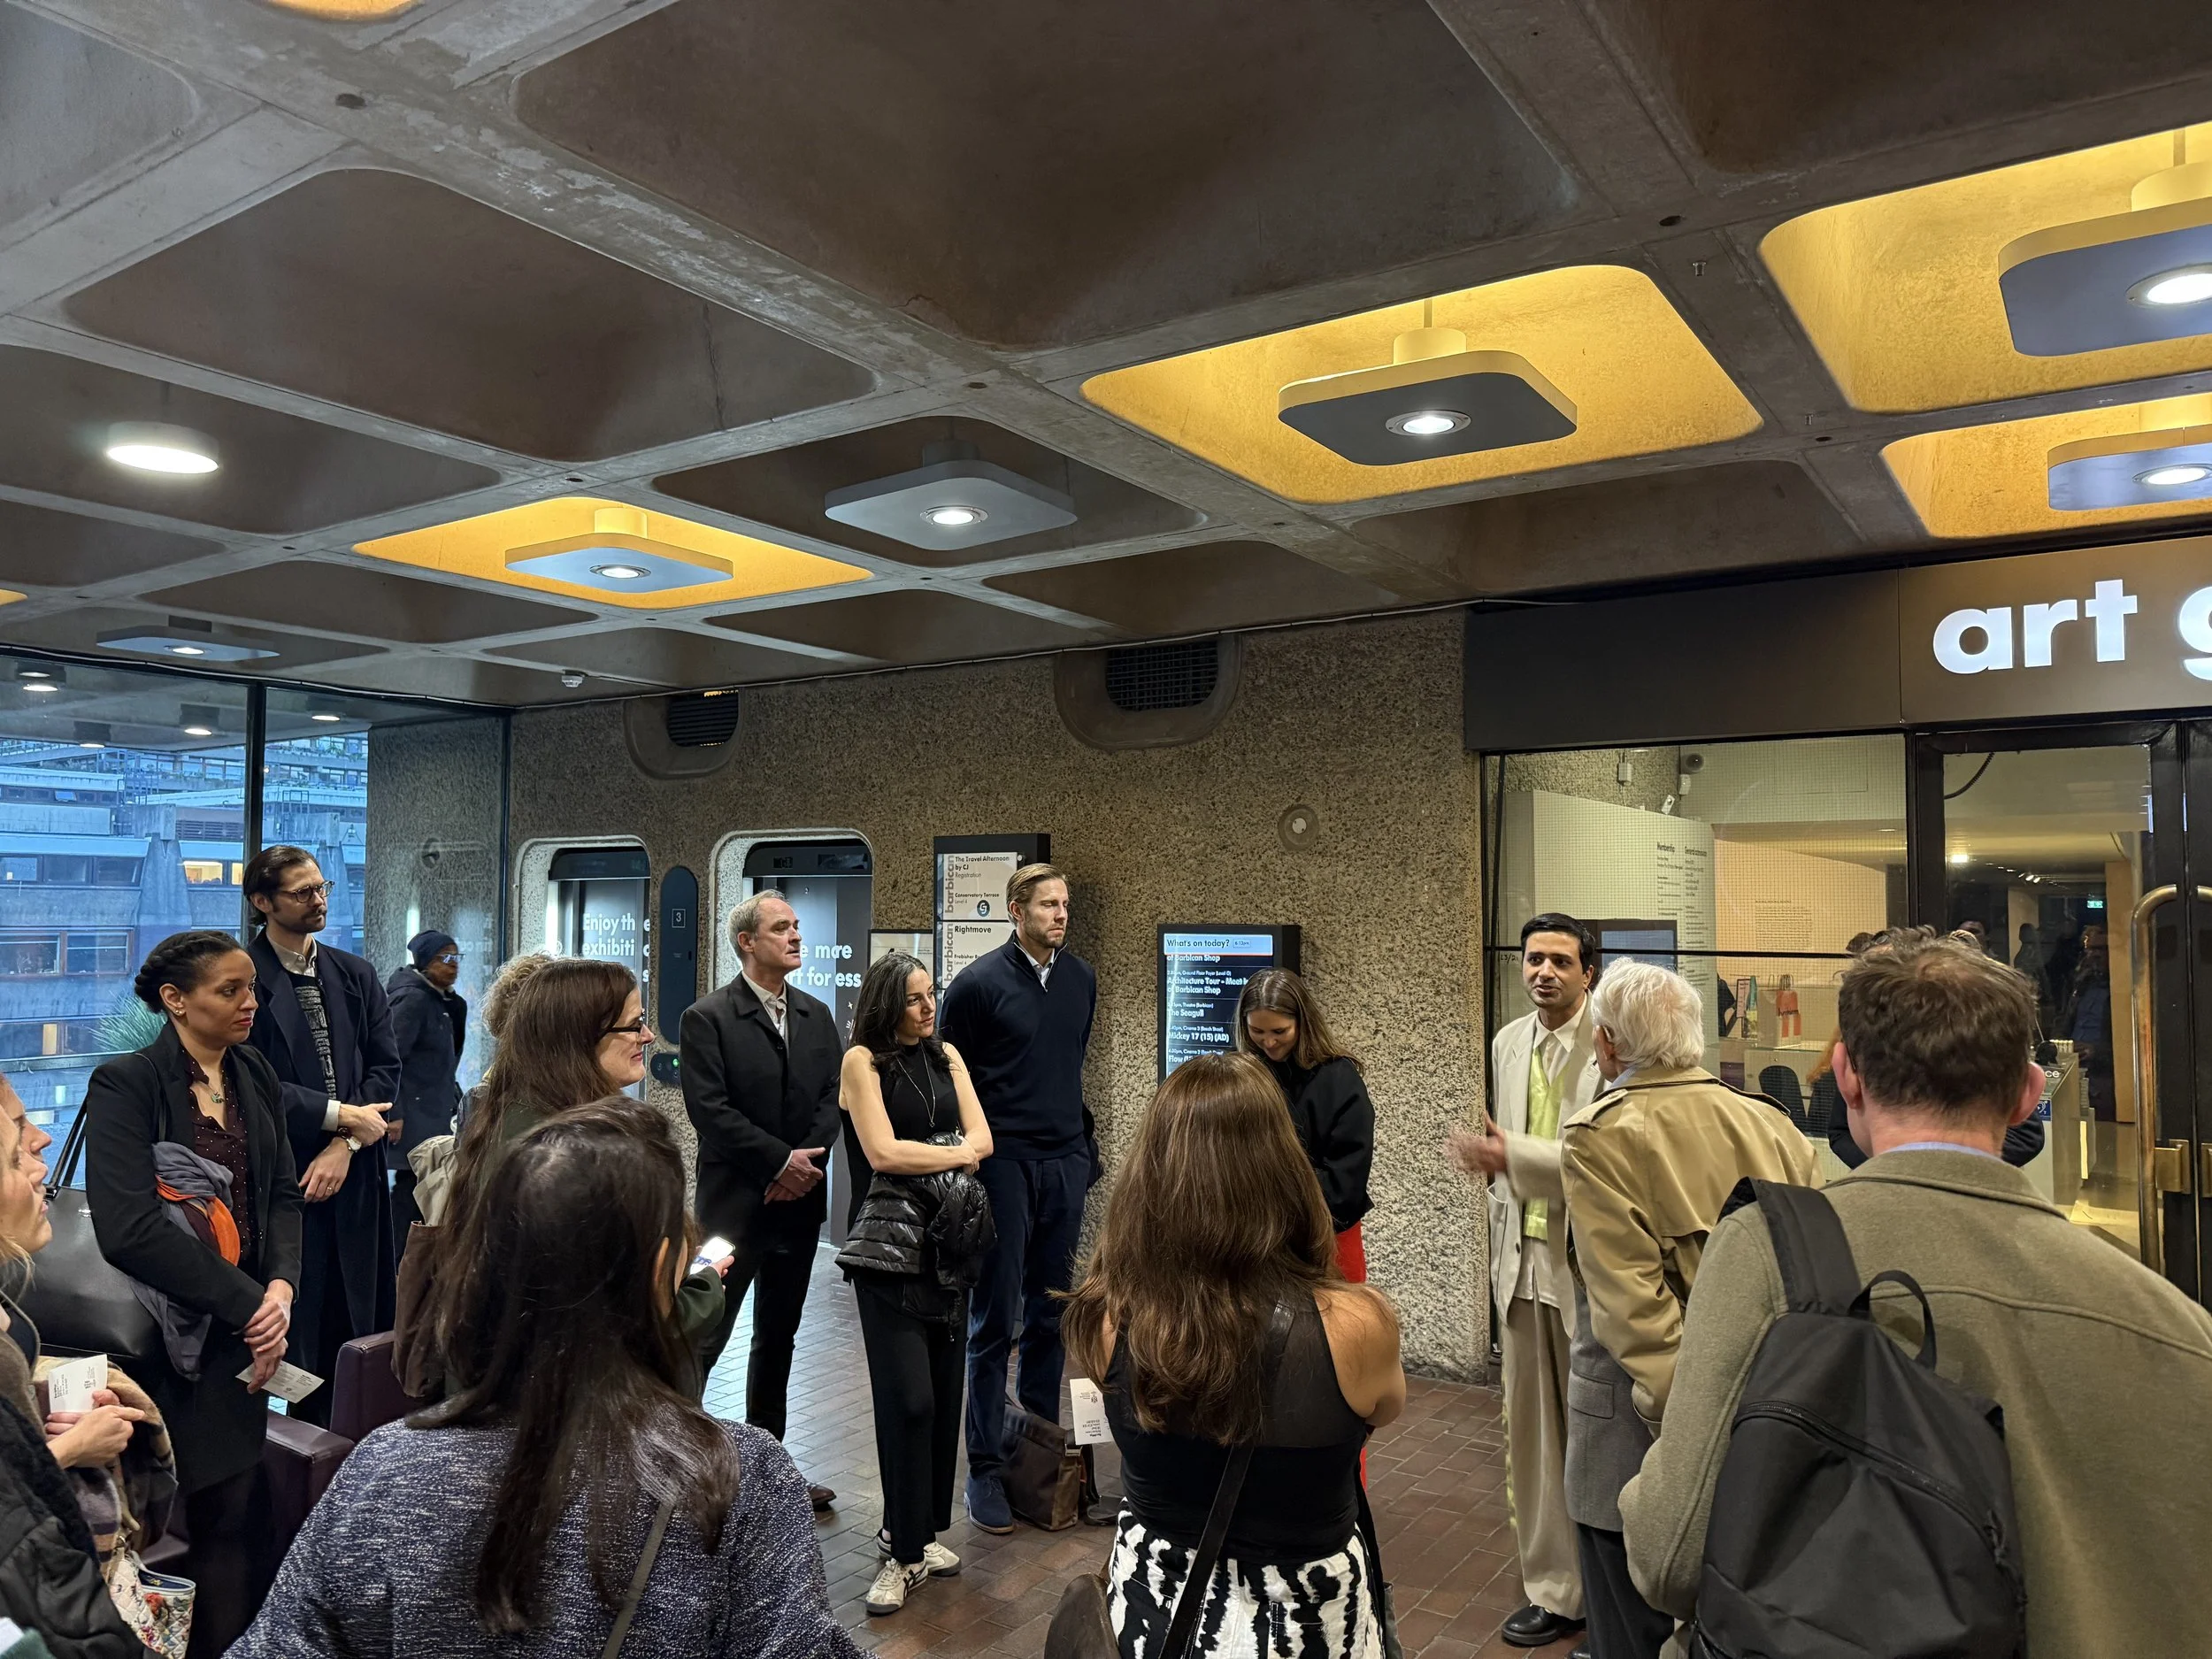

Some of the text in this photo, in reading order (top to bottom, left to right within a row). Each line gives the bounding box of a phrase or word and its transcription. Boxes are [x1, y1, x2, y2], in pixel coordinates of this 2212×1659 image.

[1932, 579, 2138, 674] art
[945, 855, 955, 913] barbican
[676, 911, 681, 922] 3
[582, 913, 619, 936] Enjoy
[954, 926, 992, 934] Rightmove
[1204, 939, 1230, 949] today?
[944, 924, 954, 982] barbican
[807, 966, 832, 986] for
[1203, 986, 1221, 995] Shop
[1180, 1009, 1204, 1018] Seagull
[1168, 1032, 1230, 1042] Mickey 17 (15) (AD)
